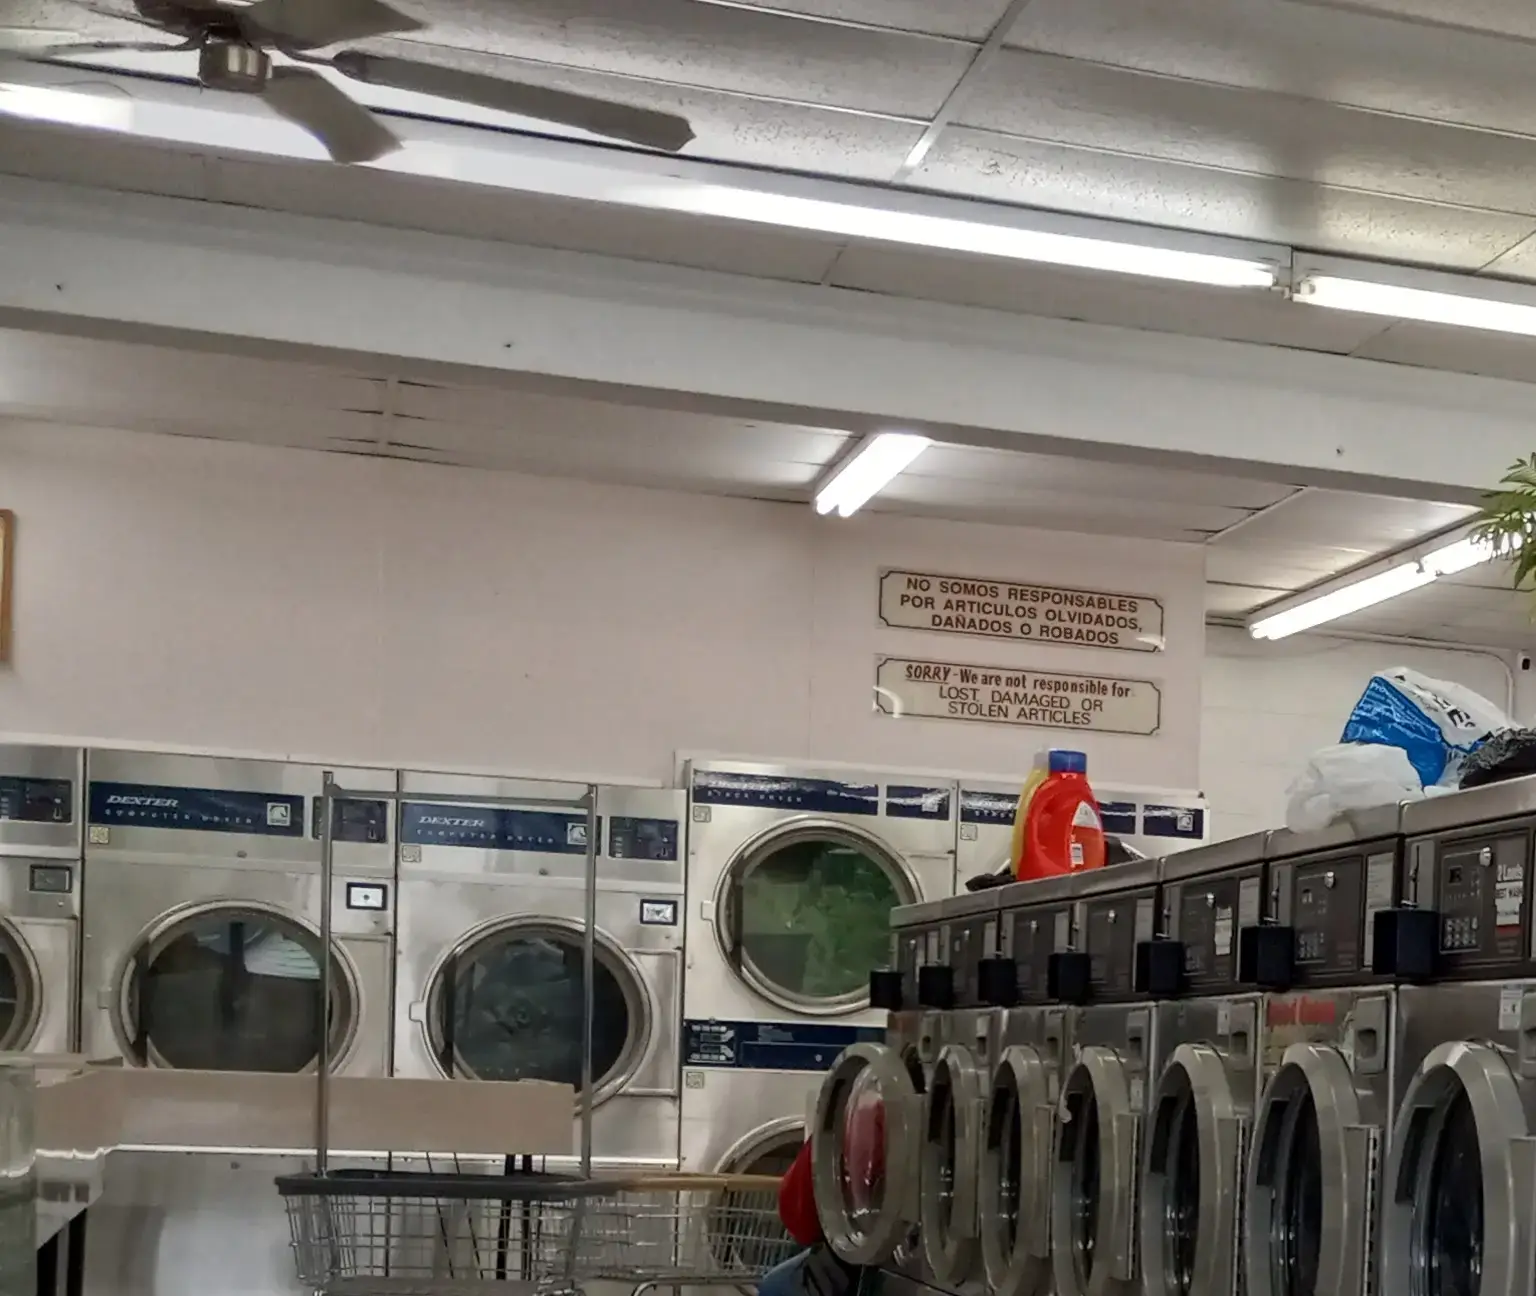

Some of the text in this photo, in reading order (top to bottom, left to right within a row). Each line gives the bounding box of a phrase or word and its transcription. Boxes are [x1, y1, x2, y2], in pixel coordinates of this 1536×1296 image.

[906, 576, 1138, 613] NO SOMOS RESPONSABLES
[900, 594, 1143, 632] POR ARTICULOS OLVIDADOS,
[931, 613, 1119, 645] DAÑADOS O ROBADOS
[981, 674, 1001, 686] are
[1005, 674, 1027, 689] not
[1033, 677, 1108, 697] responsible
[1111, 682, 1130, 697] for
[991, 690, 1071, 710] DAMAGED
[1081, 698, 1103, 712] OR
[948, 702, 1091, 725] STOLEN ARTICLES
[106, 795, 179, 808] DEXTER
[418, 816, 485, 828] DEXTER
